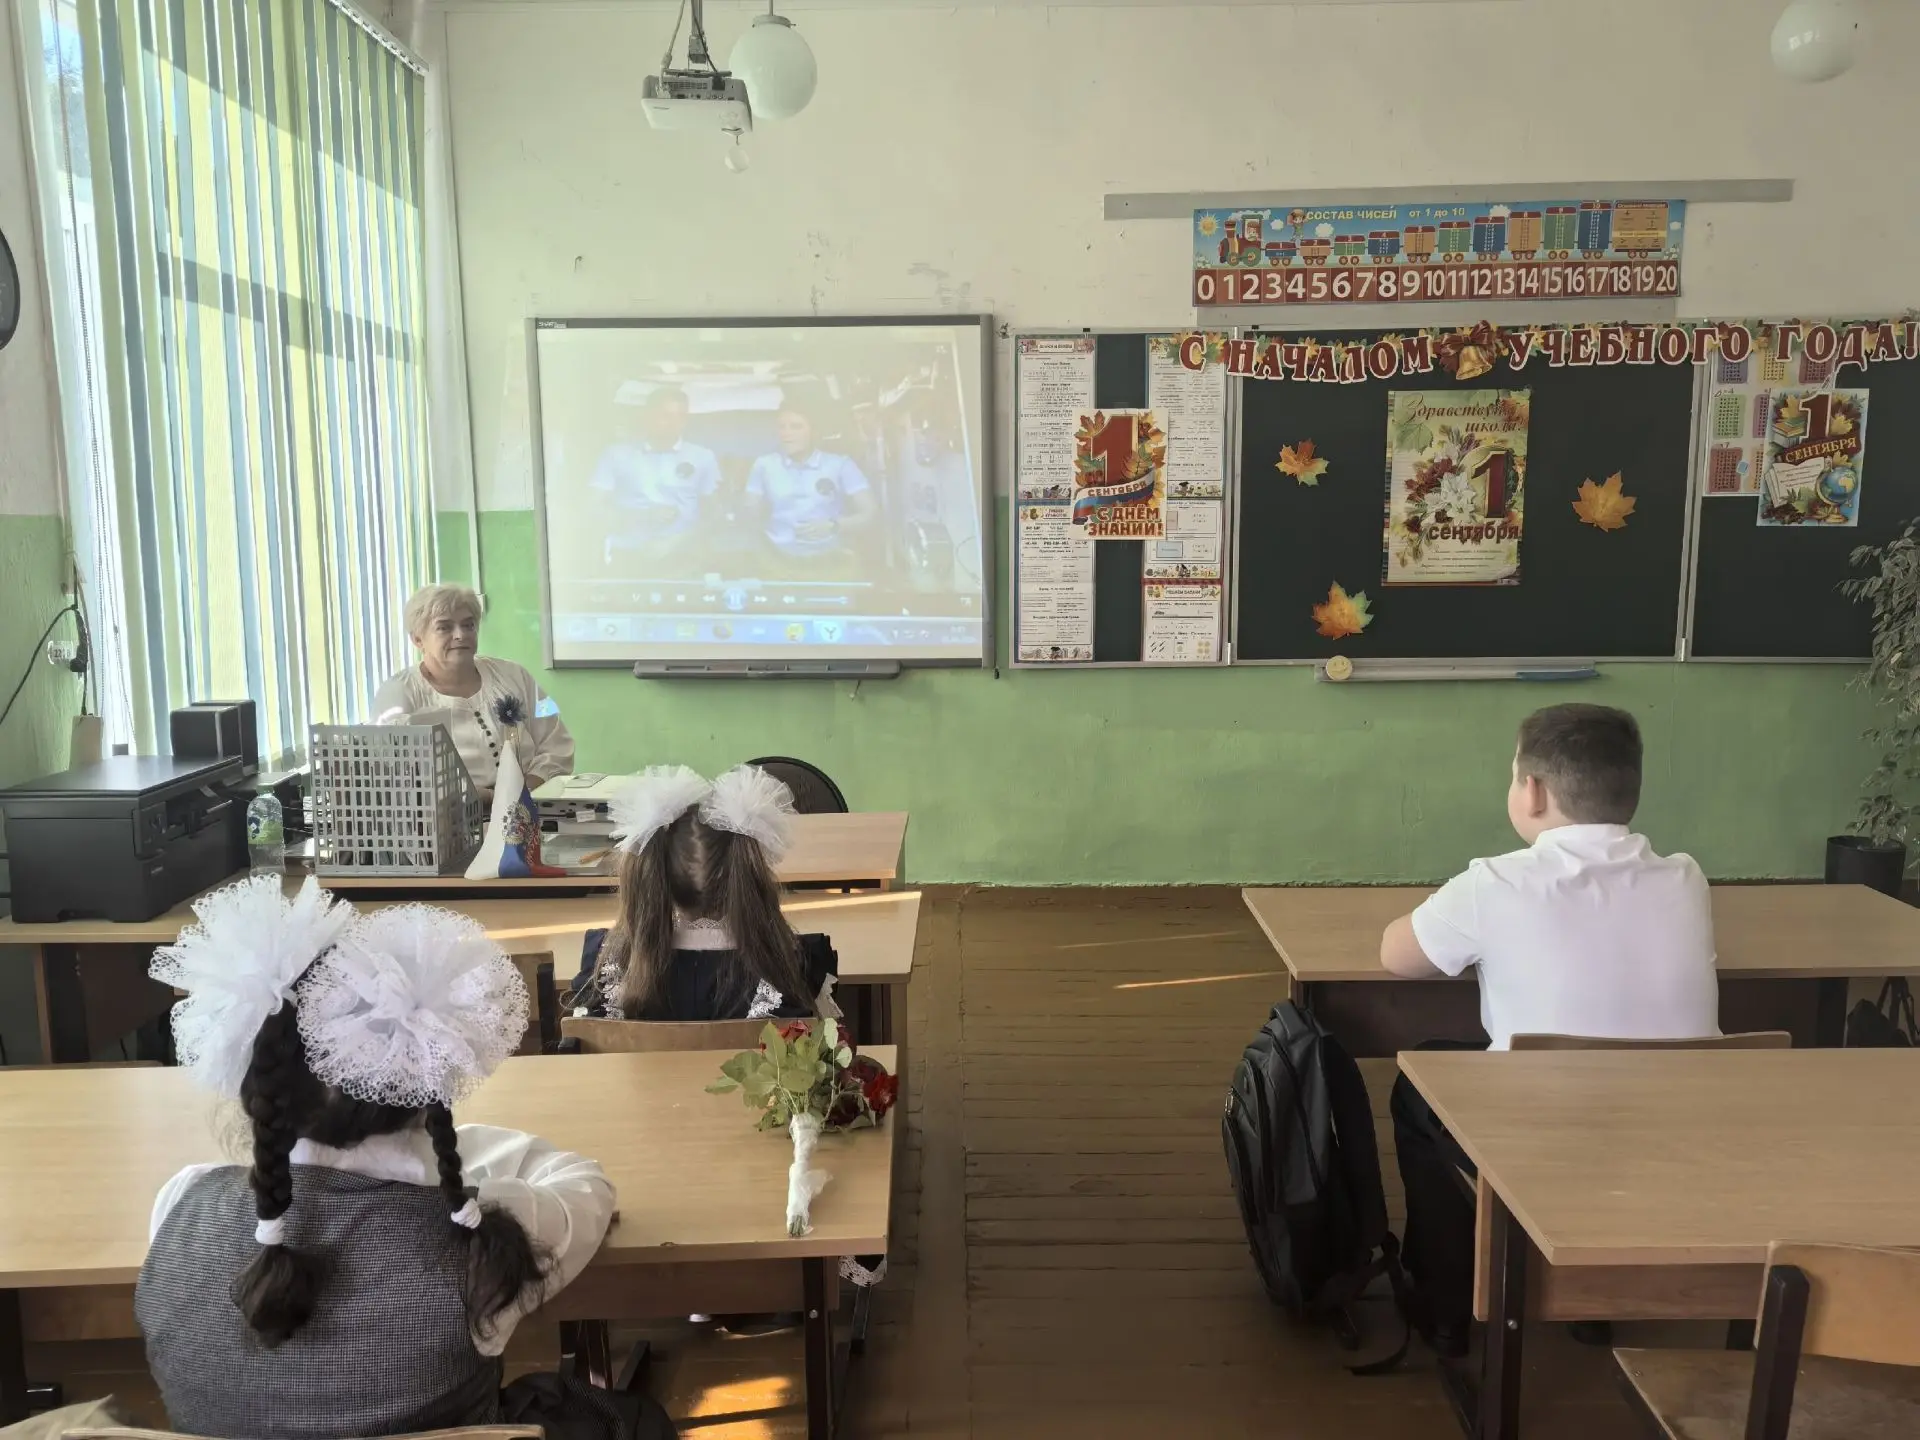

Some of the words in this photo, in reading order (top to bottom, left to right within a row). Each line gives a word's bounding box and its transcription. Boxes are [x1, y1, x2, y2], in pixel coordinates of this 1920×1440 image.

[1306, 210, 1353, 220] СОСТАВ
[1357, 208, 1396, 220] ЧИСЕЛ
[1409, 210, 1421, 218] от
[1425, 208, 1431, 216] 1
[1434, 209, 1448, 218] до
[1452, 207, 1465, 216] 10
[1197, 275, 1215, 300] 0
[1223, 275, 1234, 300] 1
[1242, 273, 1260, 300] 2
[1265, 273, 1282, 299] 3
[1286, 273, 1306, 299] 4
[1311, 272, 1328, 299] 5
[1332, 272, 1351, 299] 6
[1356, 272, 1374, 298] 7
[1378, 271, 1397, 298] 8
[1402, 270, 1420, 296] 9
[1423, 270, 1445, 296] 10
[1447, 270, 1468, 296] 11
[1470, 269, 1492, 296] 12
[1493, 268, 1515, 294] 13
[1517, 268, 1539, 294] 14
[1542, 267, 1562, 294] 15
[1564, 266, 1585, 293] 16
[1587, 266, 1609, 292] 17
[1610, 266, 1631, 292] 18
[1633, 266, 1654, 292] 19
[1656, 266, 1678, 292] 20
[1179, 335, 1207, 372] С
[1226, 335, 1433, 384] НАЧАЛОМ
[1508, 324, 1752, 370] УЧЕБНОГО
[1775, 321, 1919, 371] ГОДА!
[1799, 393, 1832, 439] 1
[1091, 414, 1138, 487] 1
[1785, 437, 1857, 464] СЕНТЯБРЯ
[1087, 481, 1147, 497] СЕНТЯБРЯ
[1470, 449, 1509, 518] 1
[1097, 507, 1109, 521] С
[1112, 504, 1160, 521] ДНЁМ
[1429, 520, 1520, 542] сентября
